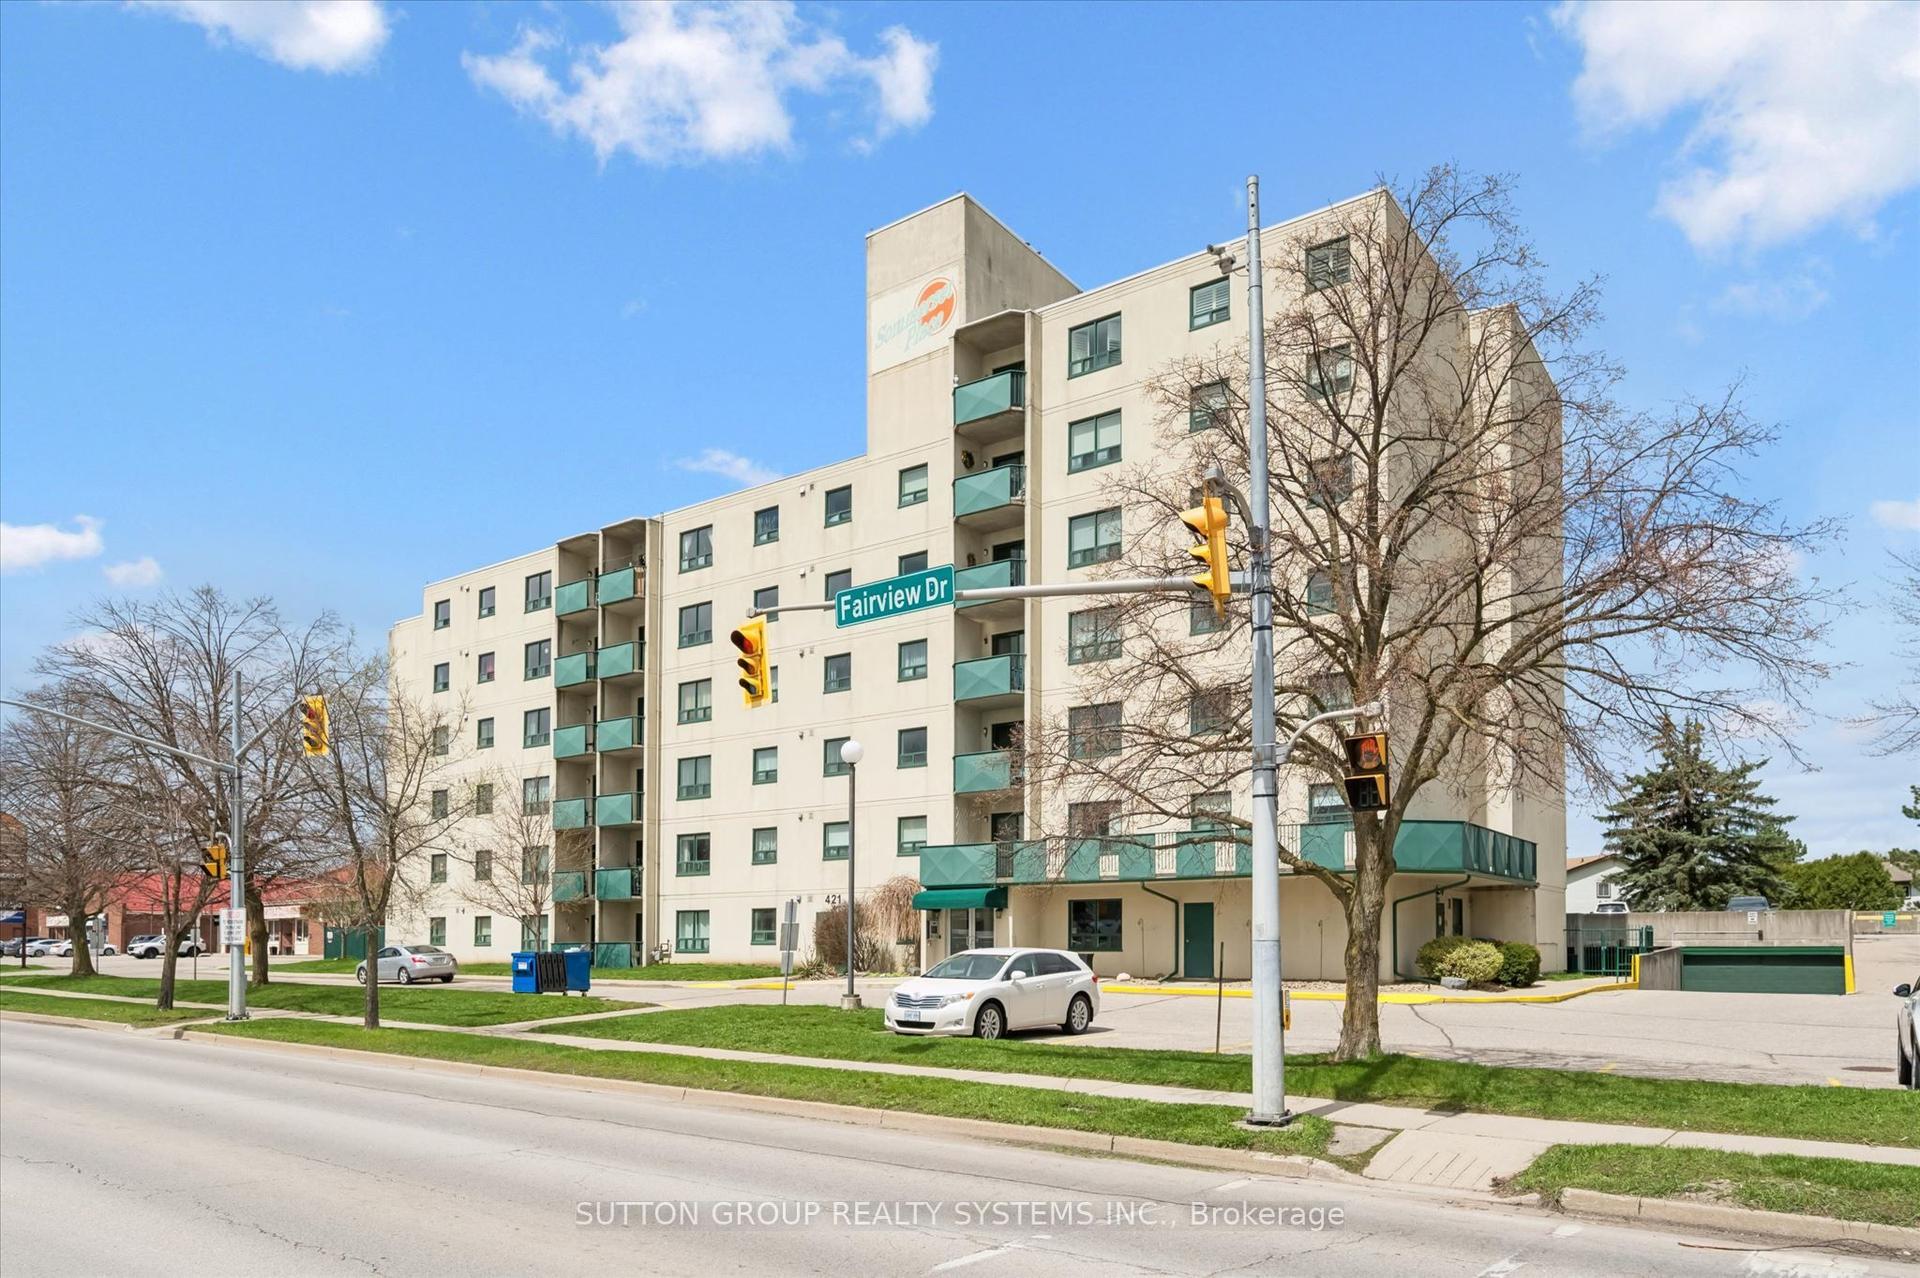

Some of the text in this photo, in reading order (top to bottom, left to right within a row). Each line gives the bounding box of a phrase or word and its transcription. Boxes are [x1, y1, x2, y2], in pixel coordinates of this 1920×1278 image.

[841, 577, 948, 620] Fairview Dr
[825, 894, 842, 905] 421
